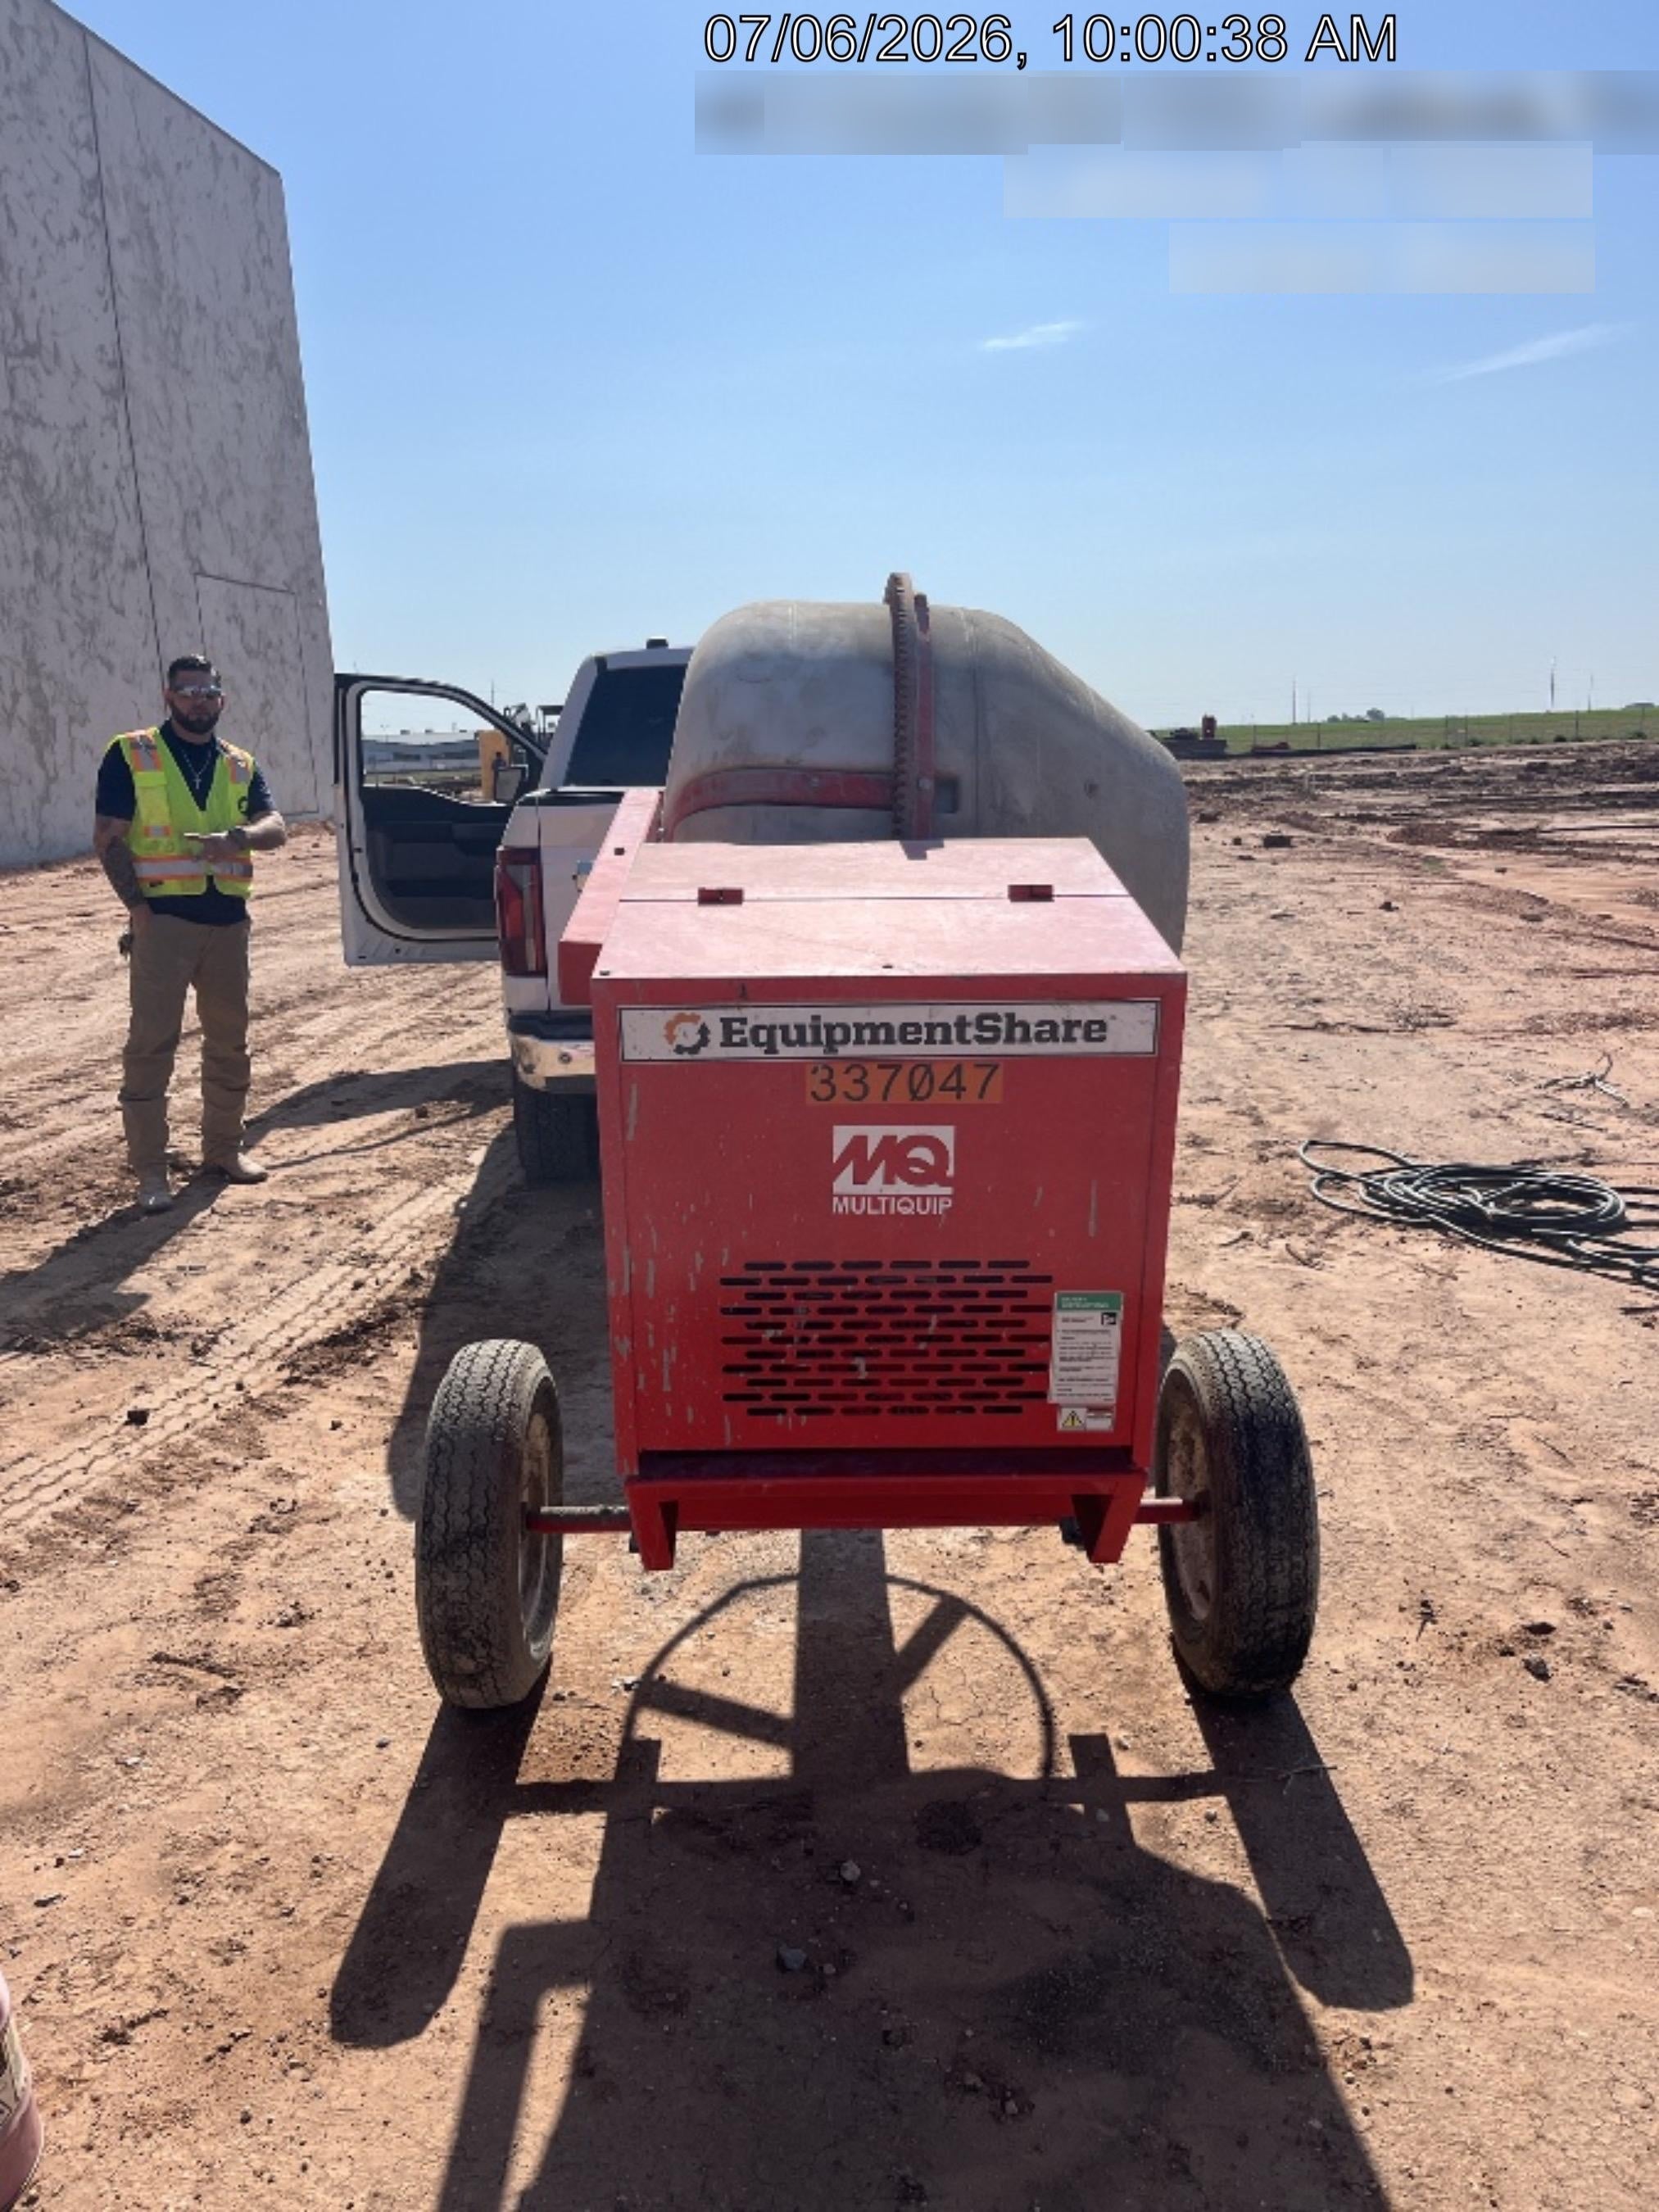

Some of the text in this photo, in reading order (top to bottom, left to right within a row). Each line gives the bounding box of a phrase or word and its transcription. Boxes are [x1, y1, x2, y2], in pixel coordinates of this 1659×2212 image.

[720, 1013, 1108, 1054] EquipmentShare
[810, 1063, 999, 1102] 337047
[832, 1135, 954, 1187] MQ
[832, 1196, 952, 1215] MULTIQUIP
